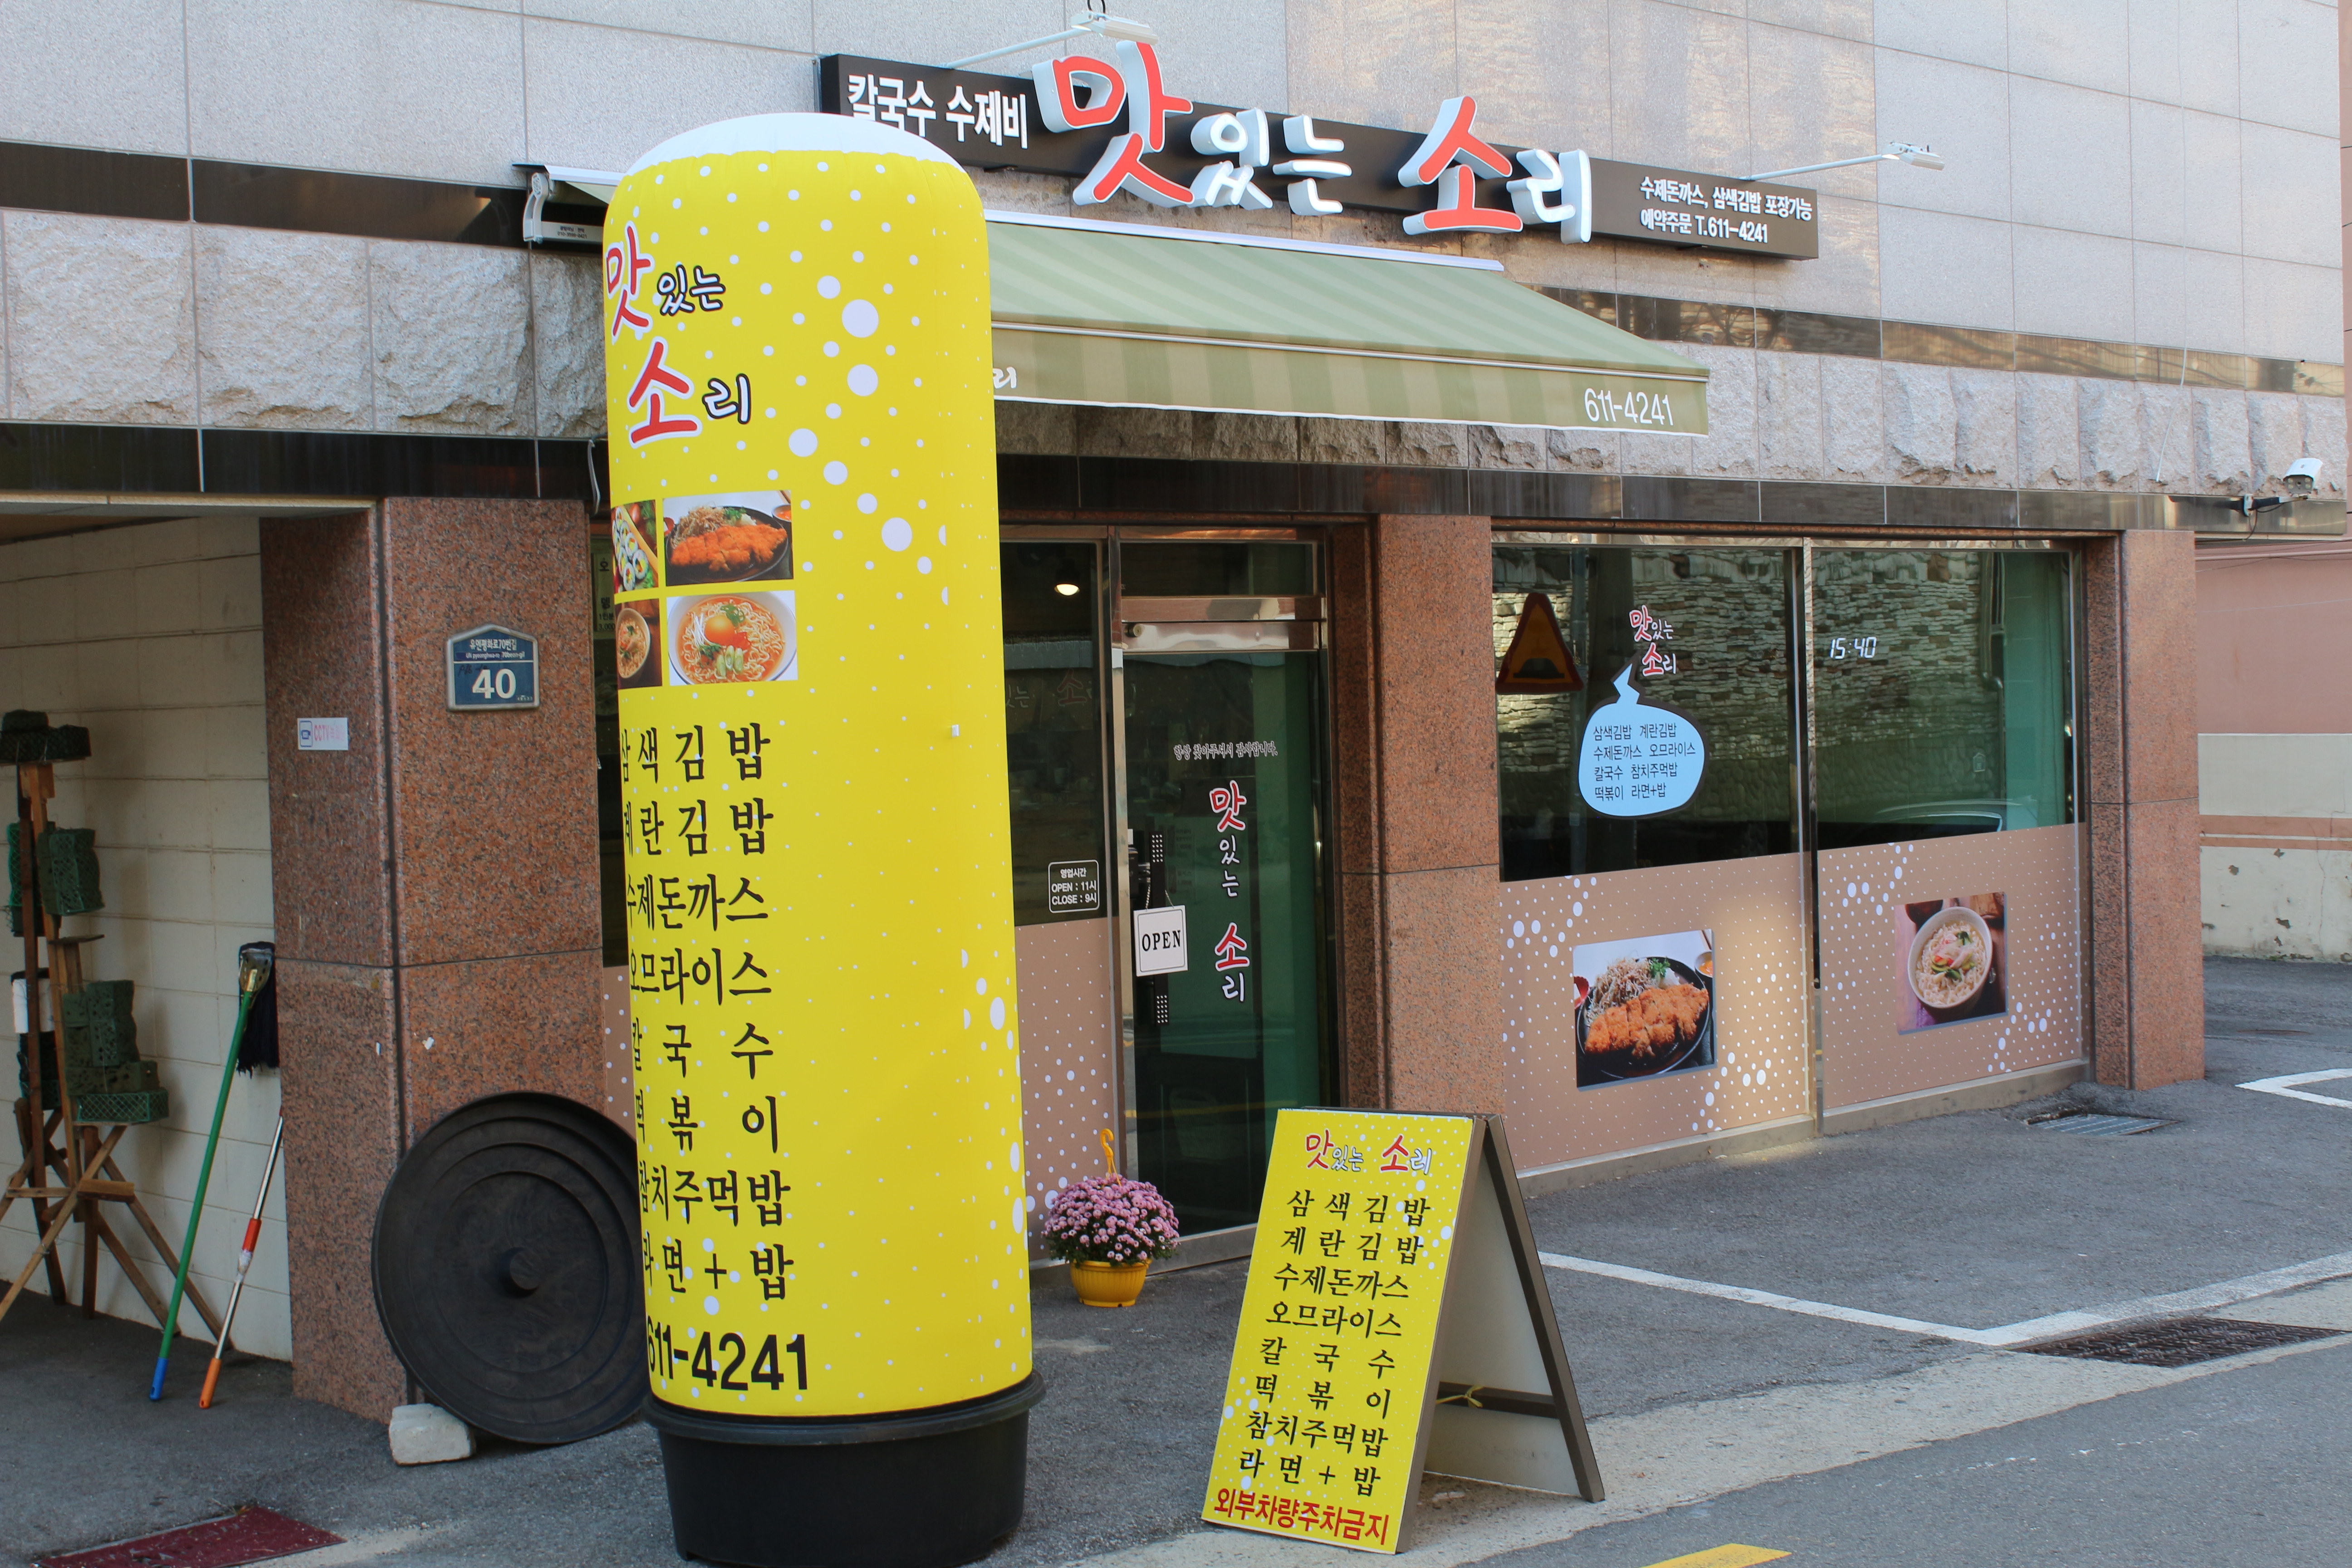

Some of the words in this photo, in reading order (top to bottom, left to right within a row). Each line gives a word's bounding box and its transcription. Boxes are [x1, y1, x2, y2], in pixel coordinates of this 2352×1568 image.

[847, 74, 936, 137] 칼국수
[945, 85, 1028, 149] 수제비
[1033, 40, 1352, 216] 맛있는
[1399, 96, 1592, 243] 소리
[1639, 176, 1709, 209] 수제돈까스,
[1712, 186, 1762, 214] 삼색김밥
[1764, 194, 1813, 221] 포장가능
[1640, 208, 1692, 235] 예약주문
[1694, 214, 1768, 243] T.611-4241
[605, 221, 726, 344] 맛있는
[627, 336, 751, 449] 소리
[1584, 388, 1674, 426] 611-4241
[1629, 604, 1674, 642] 맛있는
[1642, 642, 1676, 676] 소리
[1829, 636, 1877, 659] 15:40
[472, 668, 516, 699] 40
[1593, 724, 1632, 741] 삼색김밥
[1639, 722, 1677, 739] 계란김밥
[1173, 744, 1191, 760] 항상
[1193, 742, 1234, 760] 찾아주셔서
[1593, 744, 1642, 761] 수제돈까스
[1649, 741, 1696, 758] 오므라이스
[1594, 765, 1623, 782] 칼국수
[1631, 762, 1678, 779] 참치주먹밥
[1594, 785, 1624, 801] 떡볶이
[1631, 783, 1666, 799] 라면+밥
[1051, 883, 1073, 893] OPEN
[1081, 880, 1097, 891] 11시
[1060, 867, 1087, 879] 영업시간
[627, 874, 768, 931] 수제돈까스
[1051, 895, 1078, 906] CLOSE
[1085, 892, 1097, 903] 9시
[1142, 930, 1181, 952] OPEN
[630, 948, 772, 1006] 오므라이스
[1305, 1128, 1364, 1172] 맛있는
[1379, 1134, 1432, 1176] 소리
[639, 1160, 791, 1227] 참치주먹밥
[1274, 1263, 1409, 1301] 수제돈까스
[1265, 1301, 1402, 1339] 오므라이스
[647, 1315, 808, 1391] 611-4241
[1245, 1411, 1389, 1458] 참치주먹밥
[1214, 1488, 1389, 1546] 외부차량주차금지
